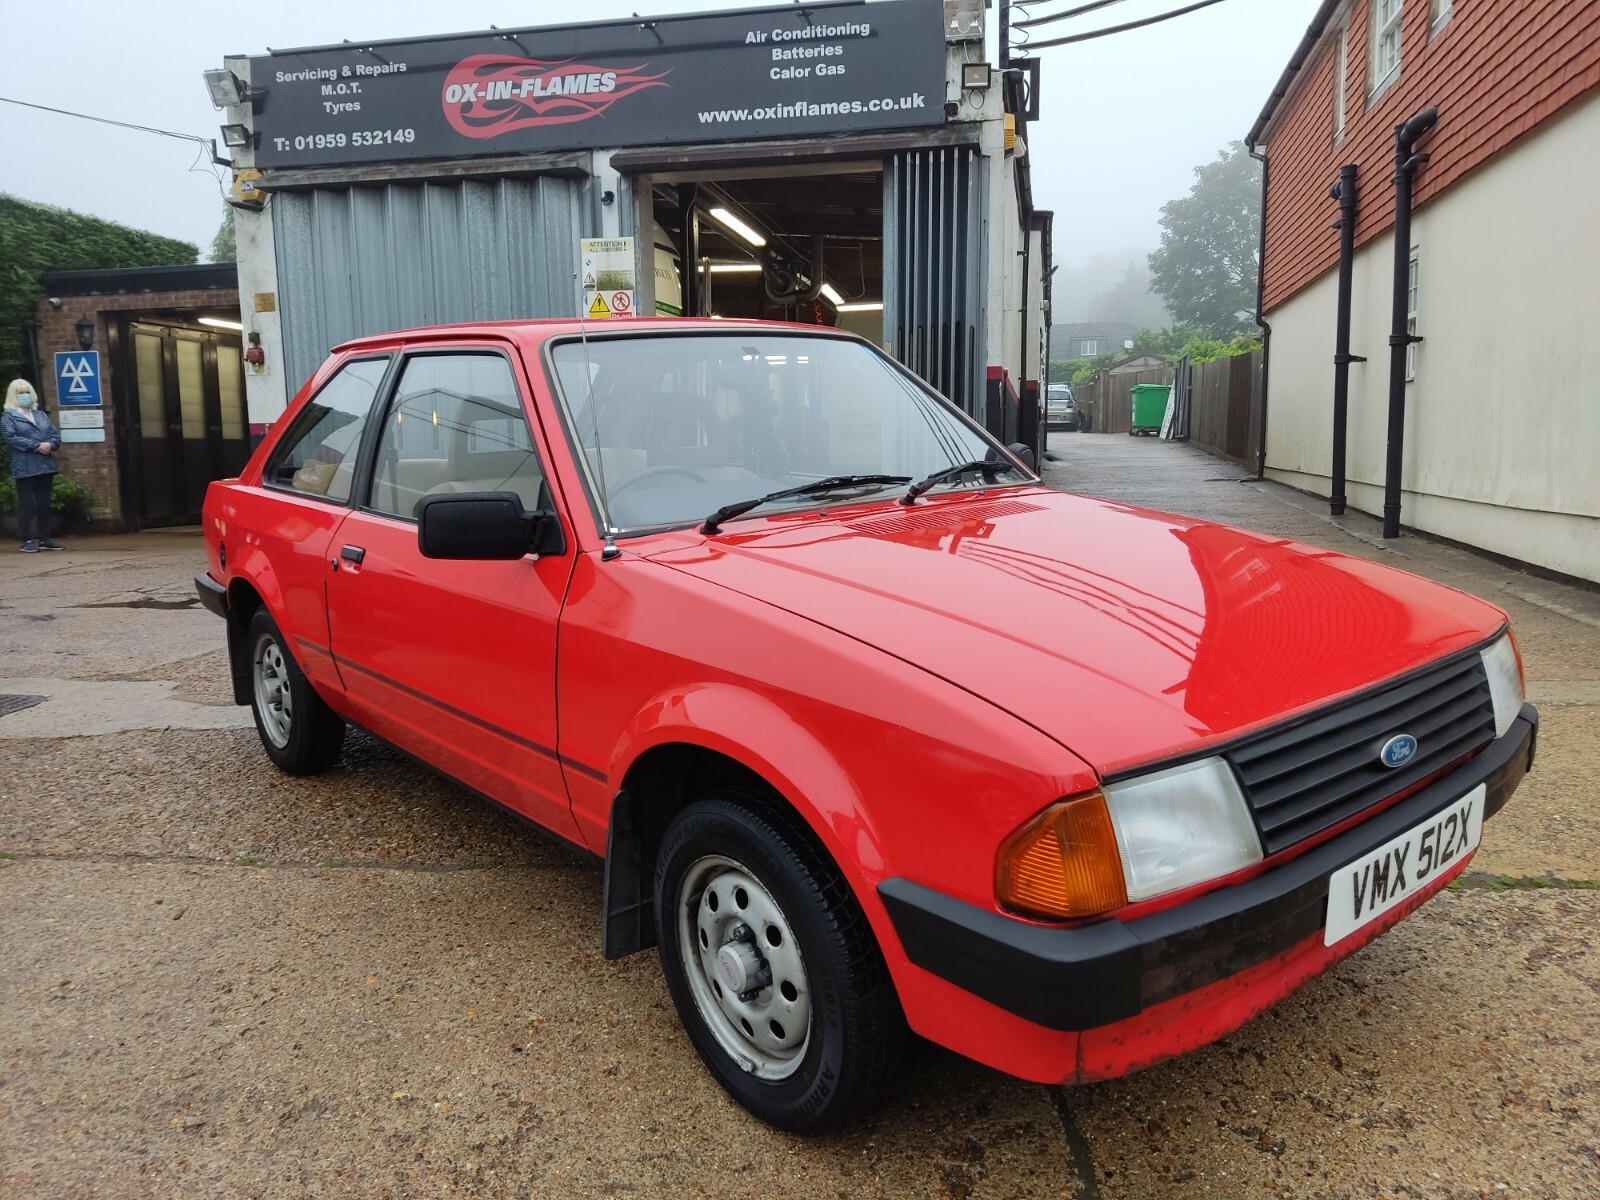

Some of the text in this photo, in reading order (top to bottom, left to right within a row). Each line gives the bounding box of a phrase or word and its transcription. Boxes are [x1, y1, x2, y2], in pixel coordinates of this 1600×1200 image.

[745, 22, 870, 44] Air Conditioning
[772, 44, 843, 61] Batteries
[275, 62, 407, 83] Servicing & Repairs
[769, 63, 846, 80] Calor Gas
[321, 82, 362, 96] M.O.T.
[445, 72, 617, 104] OX-IN-FLAMES
[323, 101, 361, 115] Tyres
[697, 92, 926, 124] www.oxinflames.co.uk
[274, 128, 415, 151] T: 01959 532149
[1391, 740, 1411, 761] Ford
[1352, 800, 1473, 921] VMX 512X
